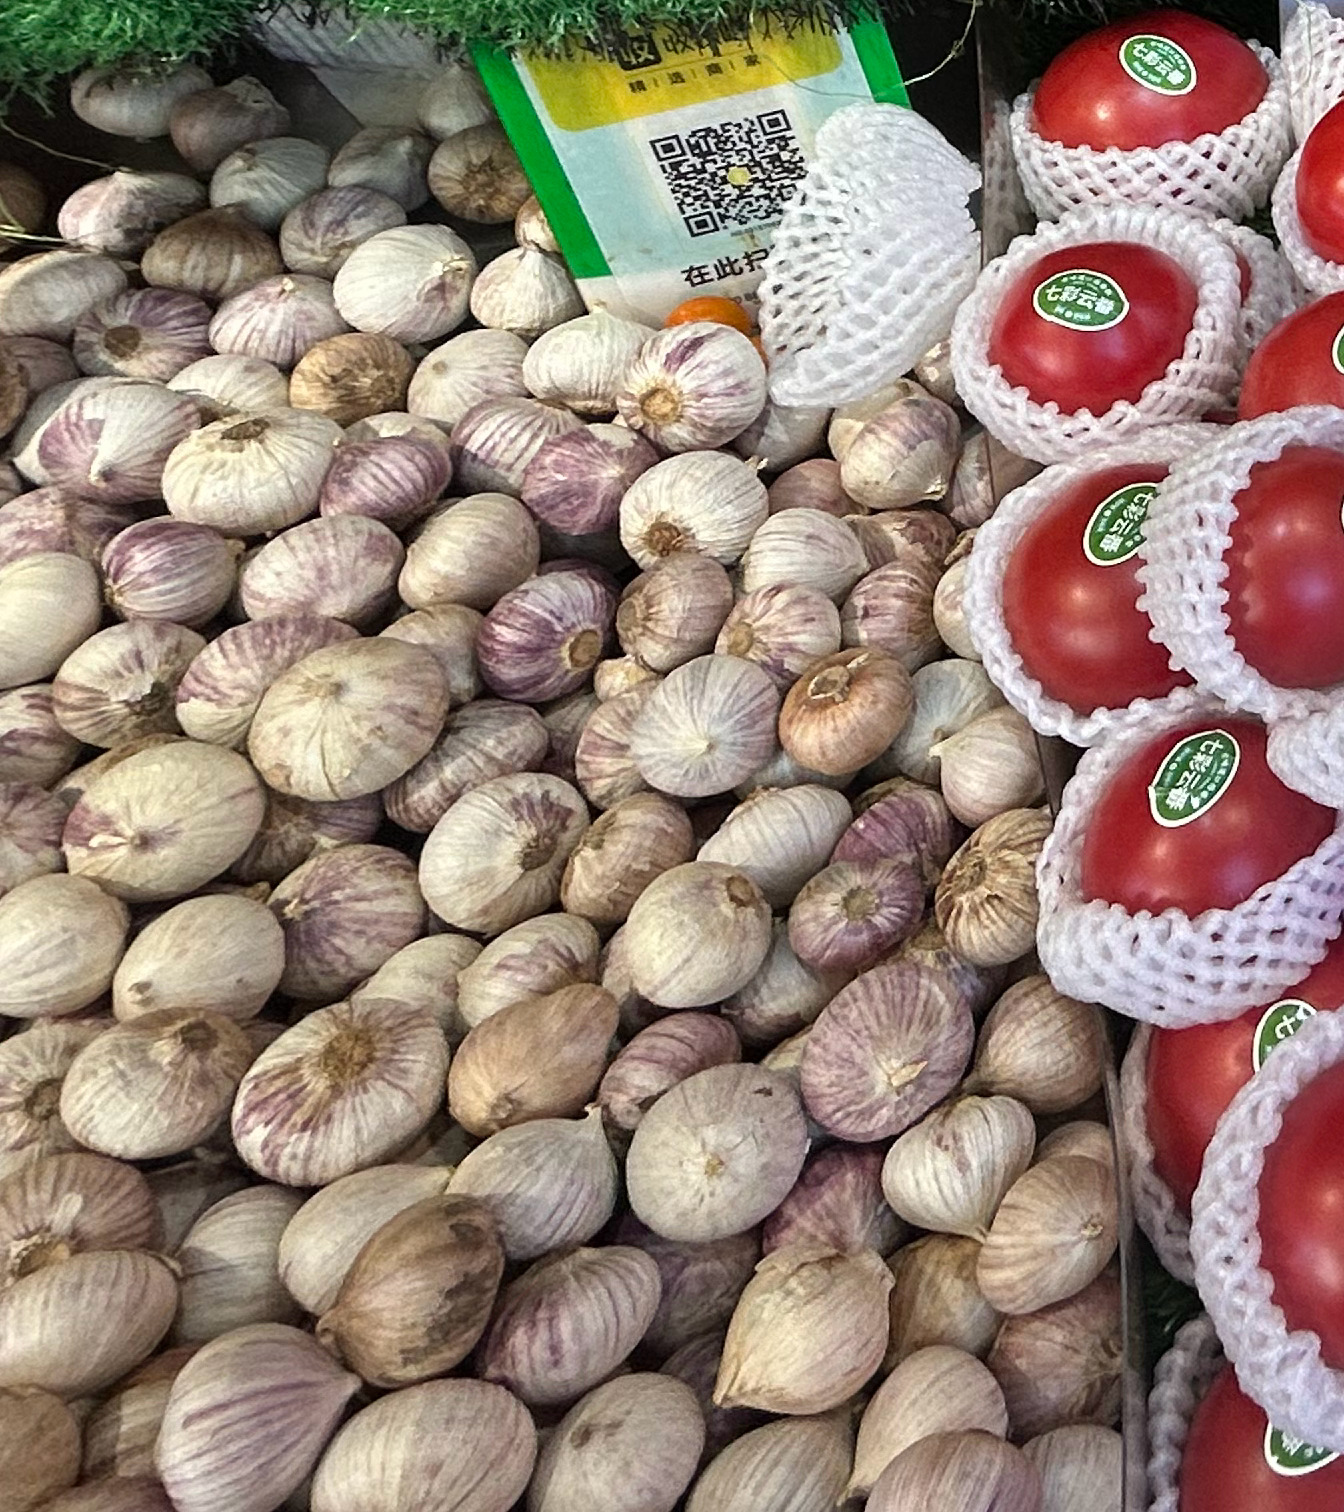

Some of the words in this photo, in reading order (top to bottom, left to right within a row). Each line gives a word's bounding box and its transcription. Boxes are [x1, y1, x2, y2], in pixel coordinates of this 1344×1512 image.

[1131, 42, 1186, 86] 七彩云番
[681, 244, 775, 287] 在此扫
[1044, 286, 1115, 316] 七彩云番
[1165, 738, 1223, 810] 七彩云番
